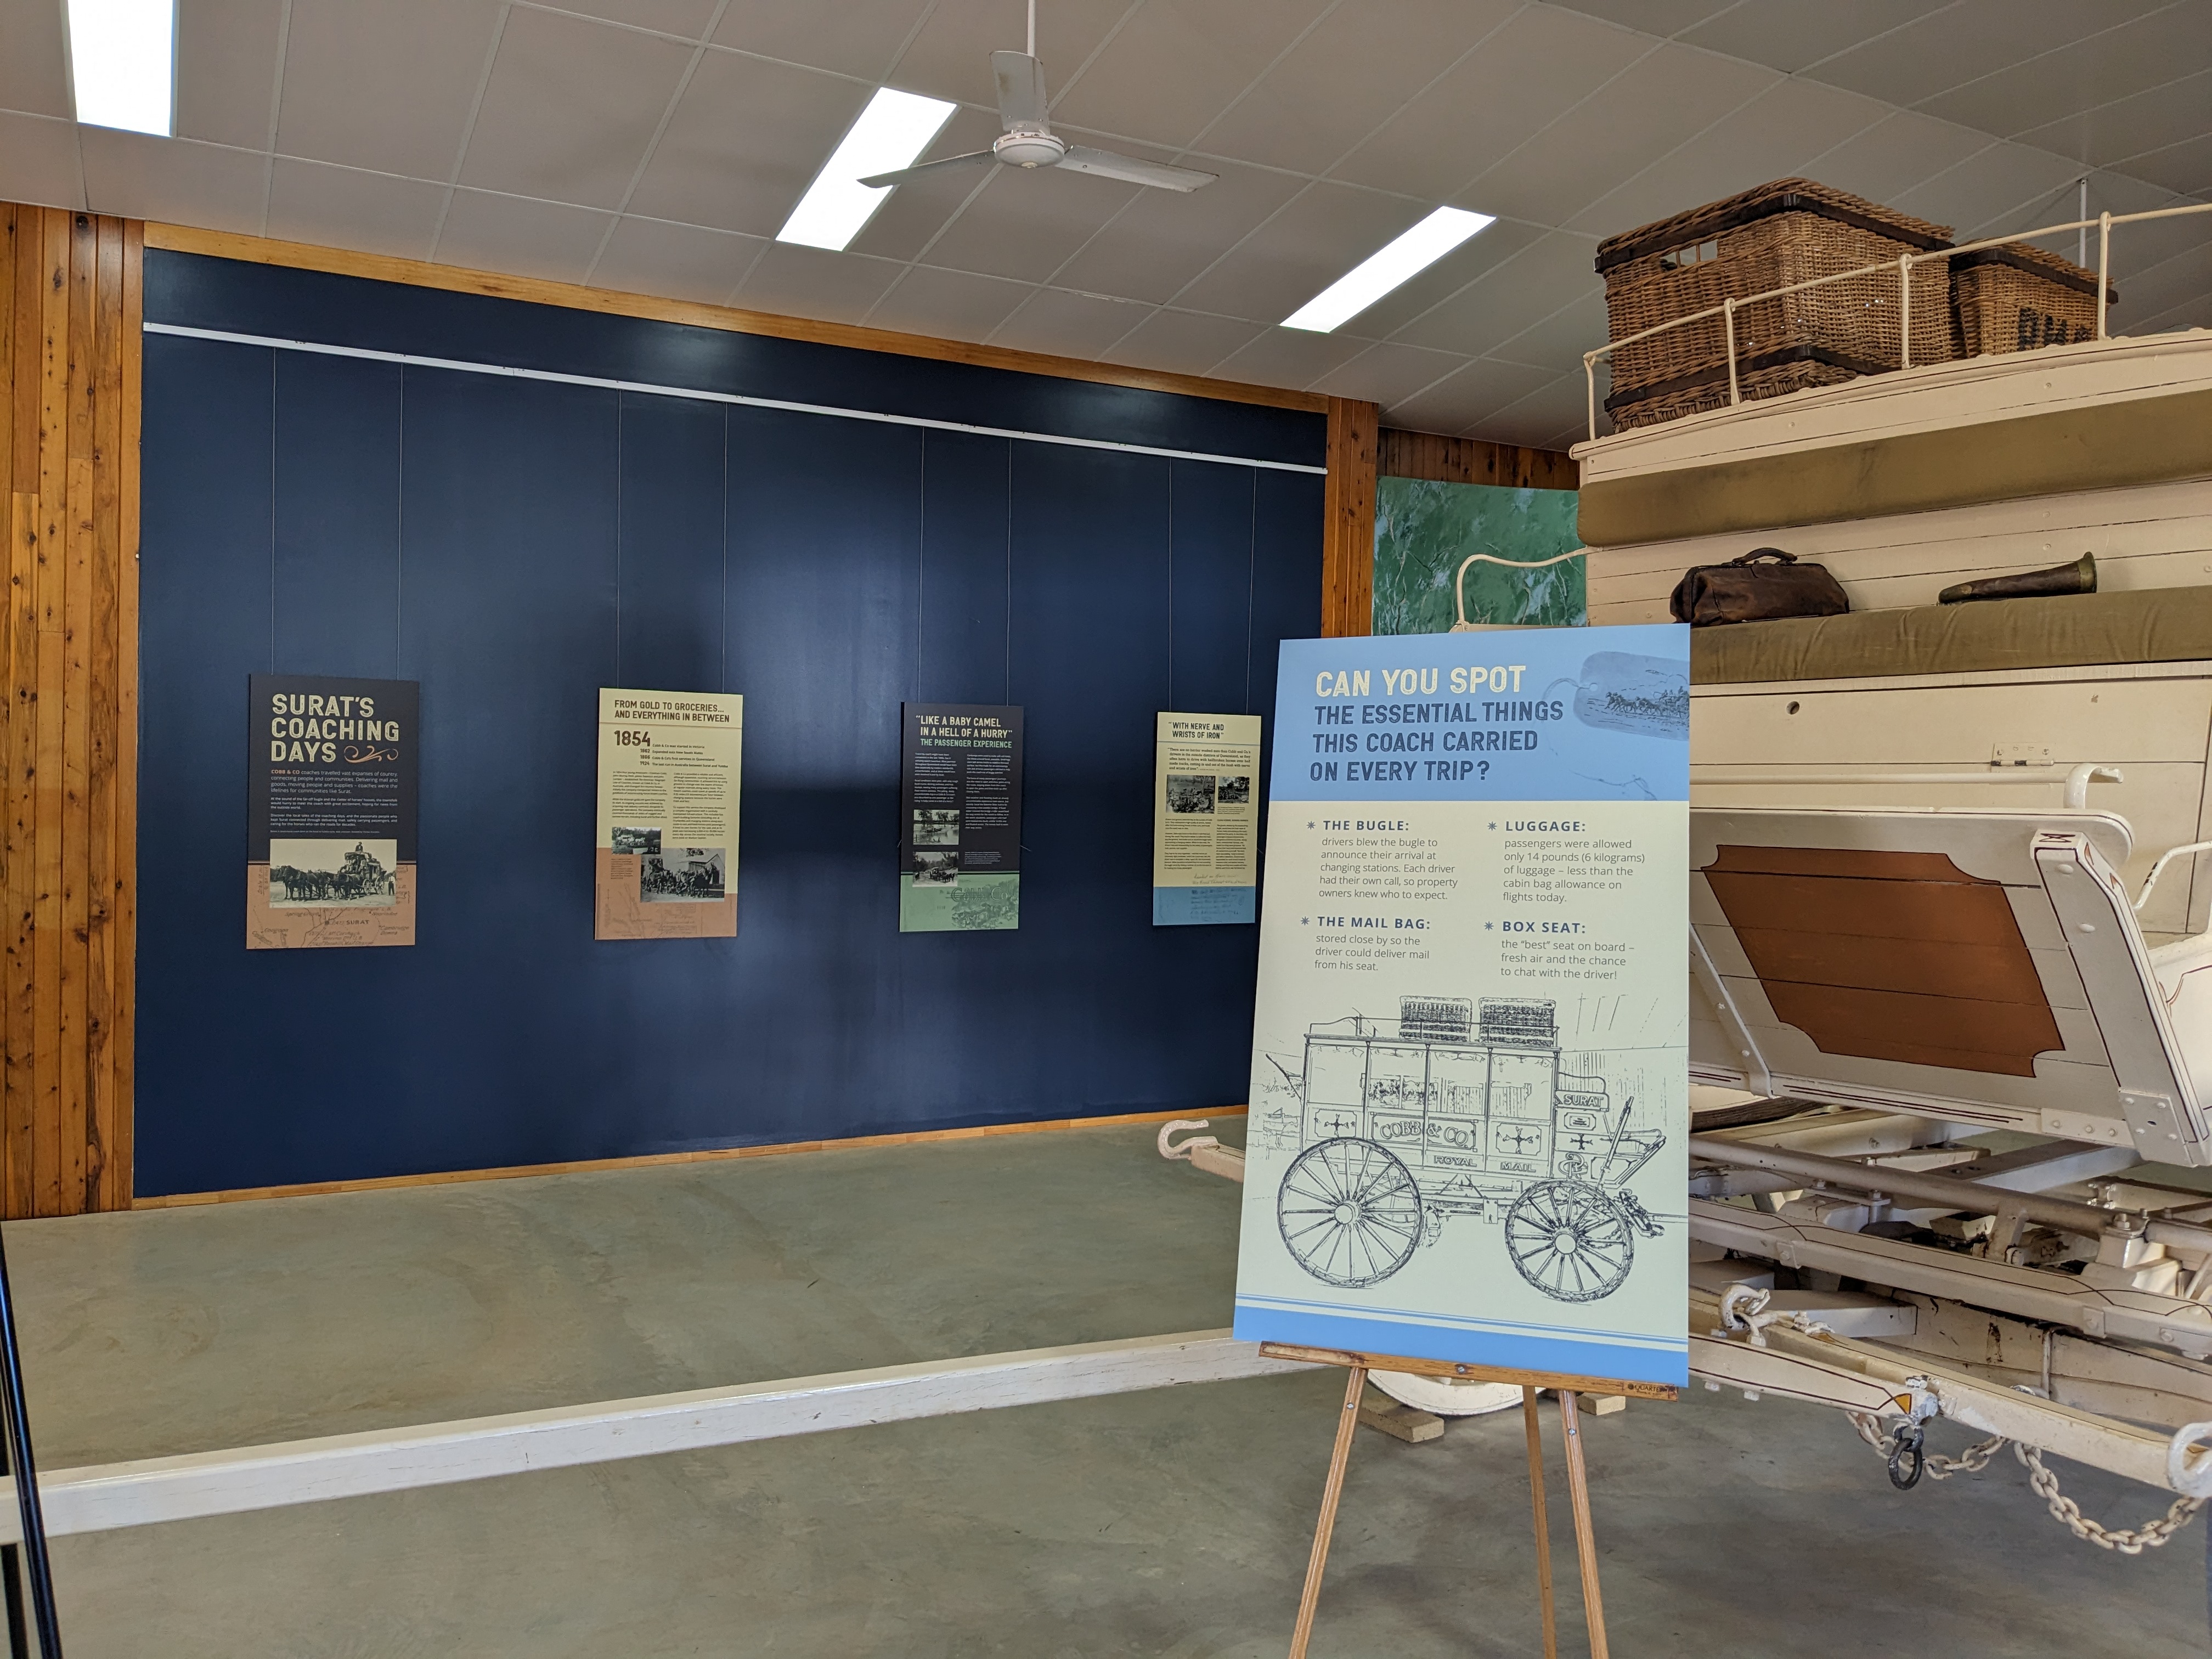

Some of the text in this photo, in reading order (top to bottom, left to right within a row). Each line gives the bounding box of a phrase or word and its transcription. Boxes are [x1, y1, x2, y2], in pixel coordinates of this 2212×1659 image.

[1316, 665, 1526, 697] CAN YOU SPOT
[273, 694, 374, 717] SURAT'S
[614, 699, 637, 708] FROM
[640, 701, 659, 709] GOLD
[614, 710, 729, 723] AND EVERYTHING IN BETWEEN
[1314, 701, 1563, 725] THE ESSENTIAL THINGS
[942, 716, 947, 725] A
[950, 716, 971, 726] BABY
[974, 718, 1001, 727] CAMEL
[272, 718, 399, 741] COACHING
[921, 727, 929, 736] IN
[931, 727, 936, 736] A
[939, 727, 959, 737] HELL
[961, 729, 972, 737] OF
[973, 729, 979, 737] A
[614, 730, 651, 747] 1854
[1313, 730, 1537, 753] THIS COACH CARRIED
[271, 741, 336, 763] DAYS
[1310, 760, 1489, 781] ON EVERY TRIP?
[1323, 821, 1408, 831] THE BUGLE:
[1506, 821, 1585, 831] LUGGAGE:
[1322, 837, 1353, 846] drivers
[1357, 838, 1378, 846] blew
[1381, 838, 1396, 846] the
[1399, 838, 1425, 849] bugle
[1505, 841, 1561, 850] passengers
[1593, 839, 1632, 848] allowed
[1370, 850, 1392, 859] their
[1395, 851, 1424, 859] arrival
[1504, 852, 1645, 864] only 14 pounds (6 kilograms)
[1321, 863, 1455, 874] changing stations. Each driver
[1504, 865, 1633, 877] of luggage less than the
[1320, 876, 1336, 884] had
[1339, 876, 1360, 884] their
[1384, 877, 1401, 886] call,
[1417, 879, 1458, 889] property
[1503, 879, 1530, 888] cabin
[1533, 879, 1551, 890] bag
[1555, 879, 1605, 889] allowance
[1355, 889, 1378, 898] knew
[1380, 890, 1400, 898] who
[1414, 892, 1447, 901] expect.
[1503, 892, 1566, 904] flights today.
[1317, 916, 1430, 929] THE MAIL BAG:
[1503, 921, 1585, 933] BOX SEAT:
[1316, 934, 1346, 943] stored
[1350, 935, 1373, 944] close
[1376, 935, 1388, 946] by
[1404, 936, 1420, 945] the
[1502, 939, 1517, 949] the
[1521, 940, 1550, 949] "best"
[1595, 942, 1625, 951] board
[1316, 947, 1429, 959] driver could deliver mail
[1314, 960, 1336, 969] from
[1340, 961, 1353, 969] his
[1502, 953, 1626, 966] fresh air and the chance
[1514, 967, 1536, 977] chat
[1539, 968, 1560, 977] with
[1564, 969, 1580, 978] the
[1584, 969, 1616, 979] driver!
[1565, 1094, 1604, 1107] SURAT
[1380, 1121, 1421, 1139] COBB
[1427, 1123, 1440, 1138] &
[1434, 1155, 1536, 1172] ROYAL MAIL
